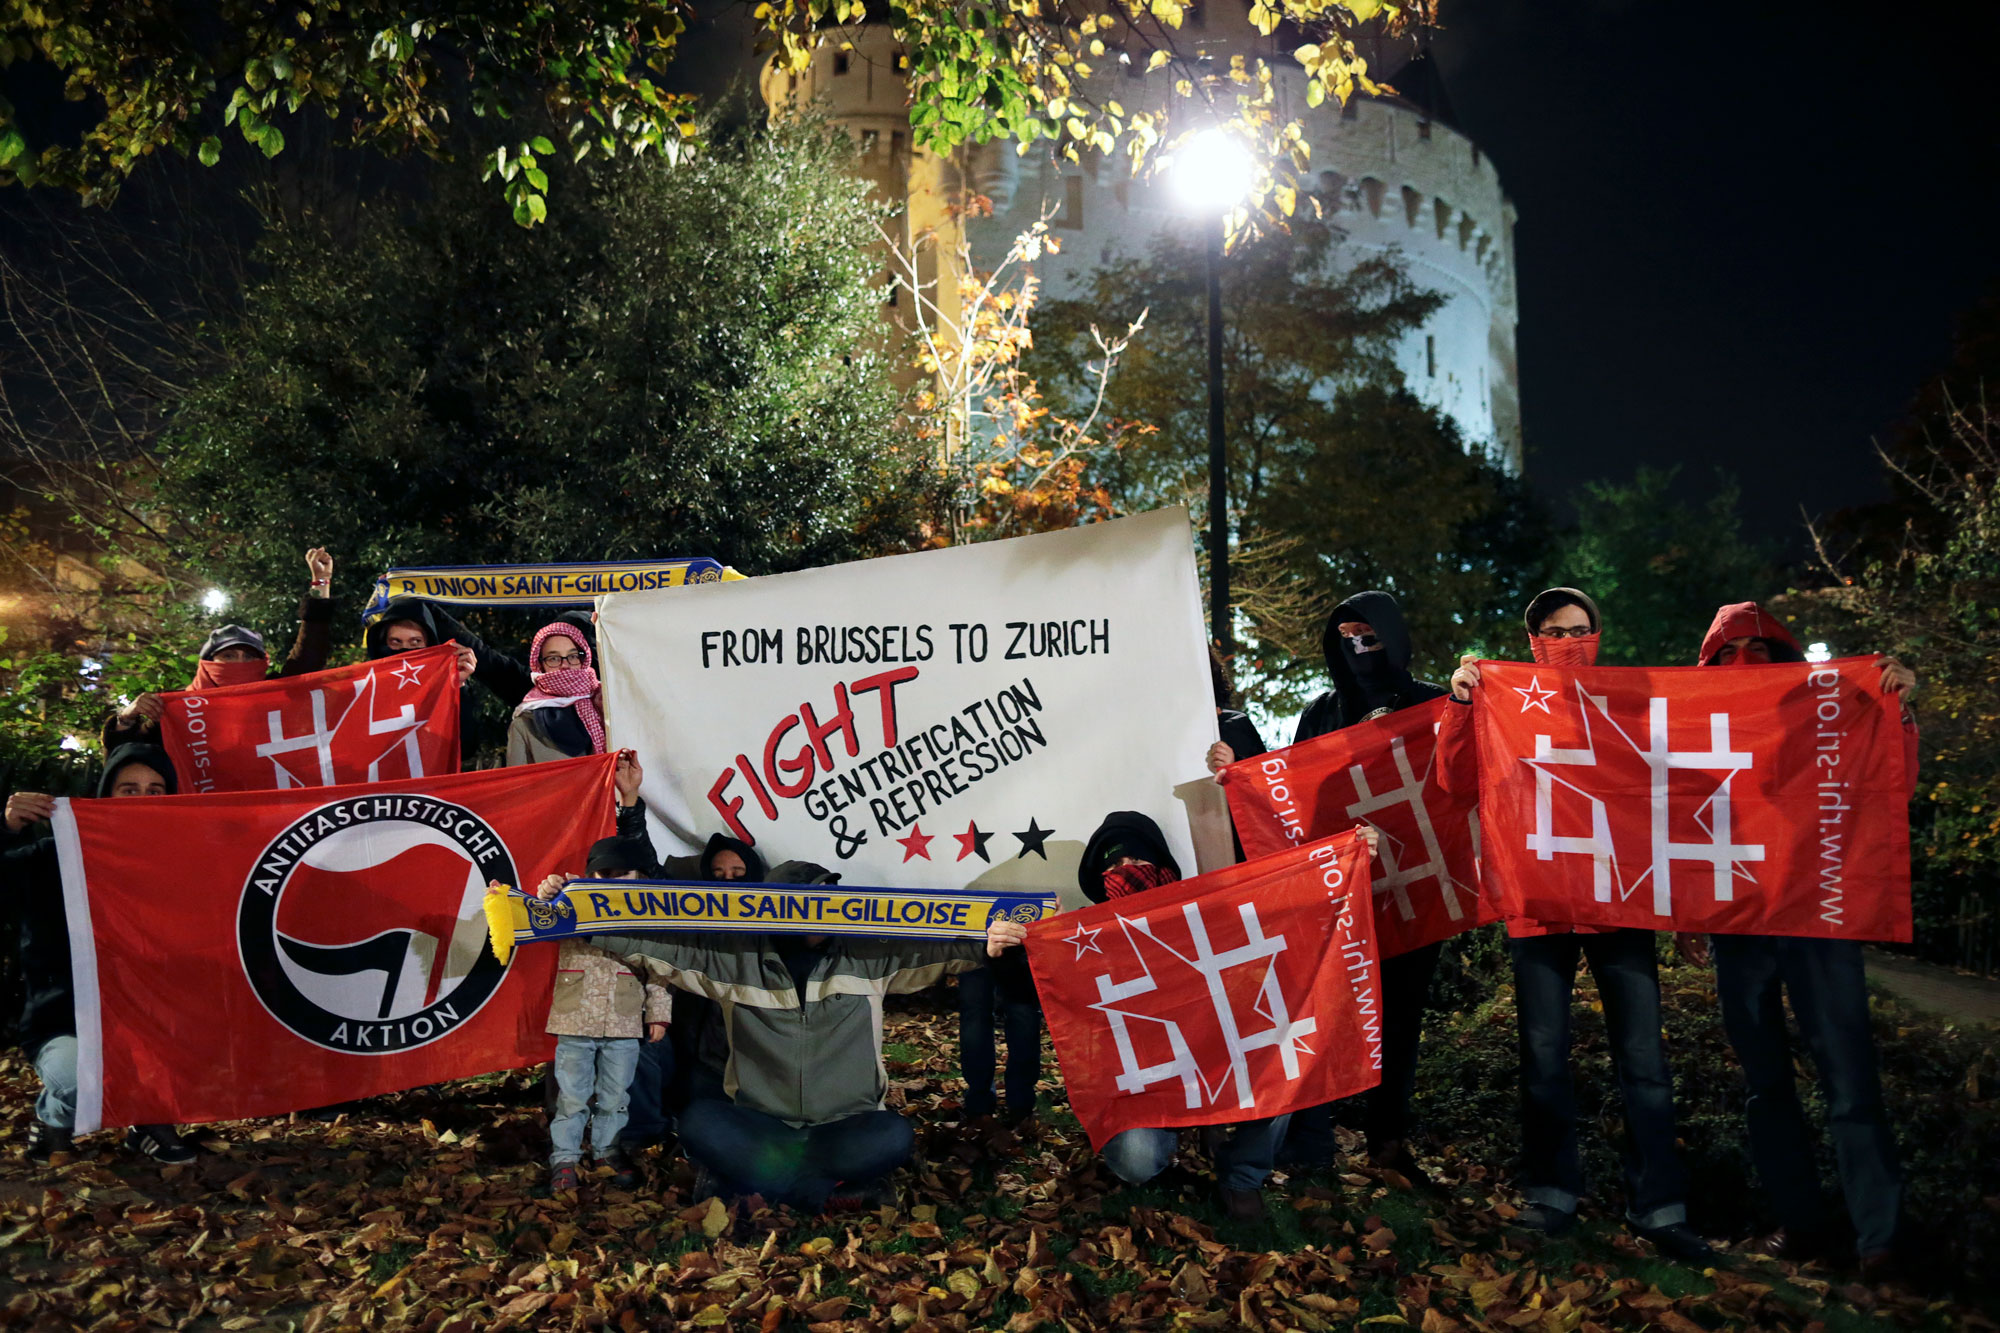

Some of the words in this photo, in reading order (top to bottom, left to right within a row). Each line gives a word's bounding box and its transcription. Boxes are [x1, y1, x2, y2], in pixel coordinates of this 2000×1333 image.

[424, 576, 498, 597] UNION
[503, 570, 671, 595] SAINT-GILLOISE
[701, 628, 783, 668] FROM
[796, 625, 933, 665] BRUSSELS
[949, 623, 988, 664] TO
[1004, 618, 1110, 660] ZURICH
[706, 665, 919, 847] FIGHT
[803, 677, 1043, 821] GENTRIFICATION
[829, 815, 868, 860] &
[869, 716, 1047, 837] REPRESSION
[254, 799, 501, 896] ANTIFASCHISTISCHE
[588, 893, 621, 918] R.
[624, 892, 729, 918] UNION
[738, 894, 971, 926] SAINT-GILLOISE
[329, 1002, 460, 1048] AKTION
